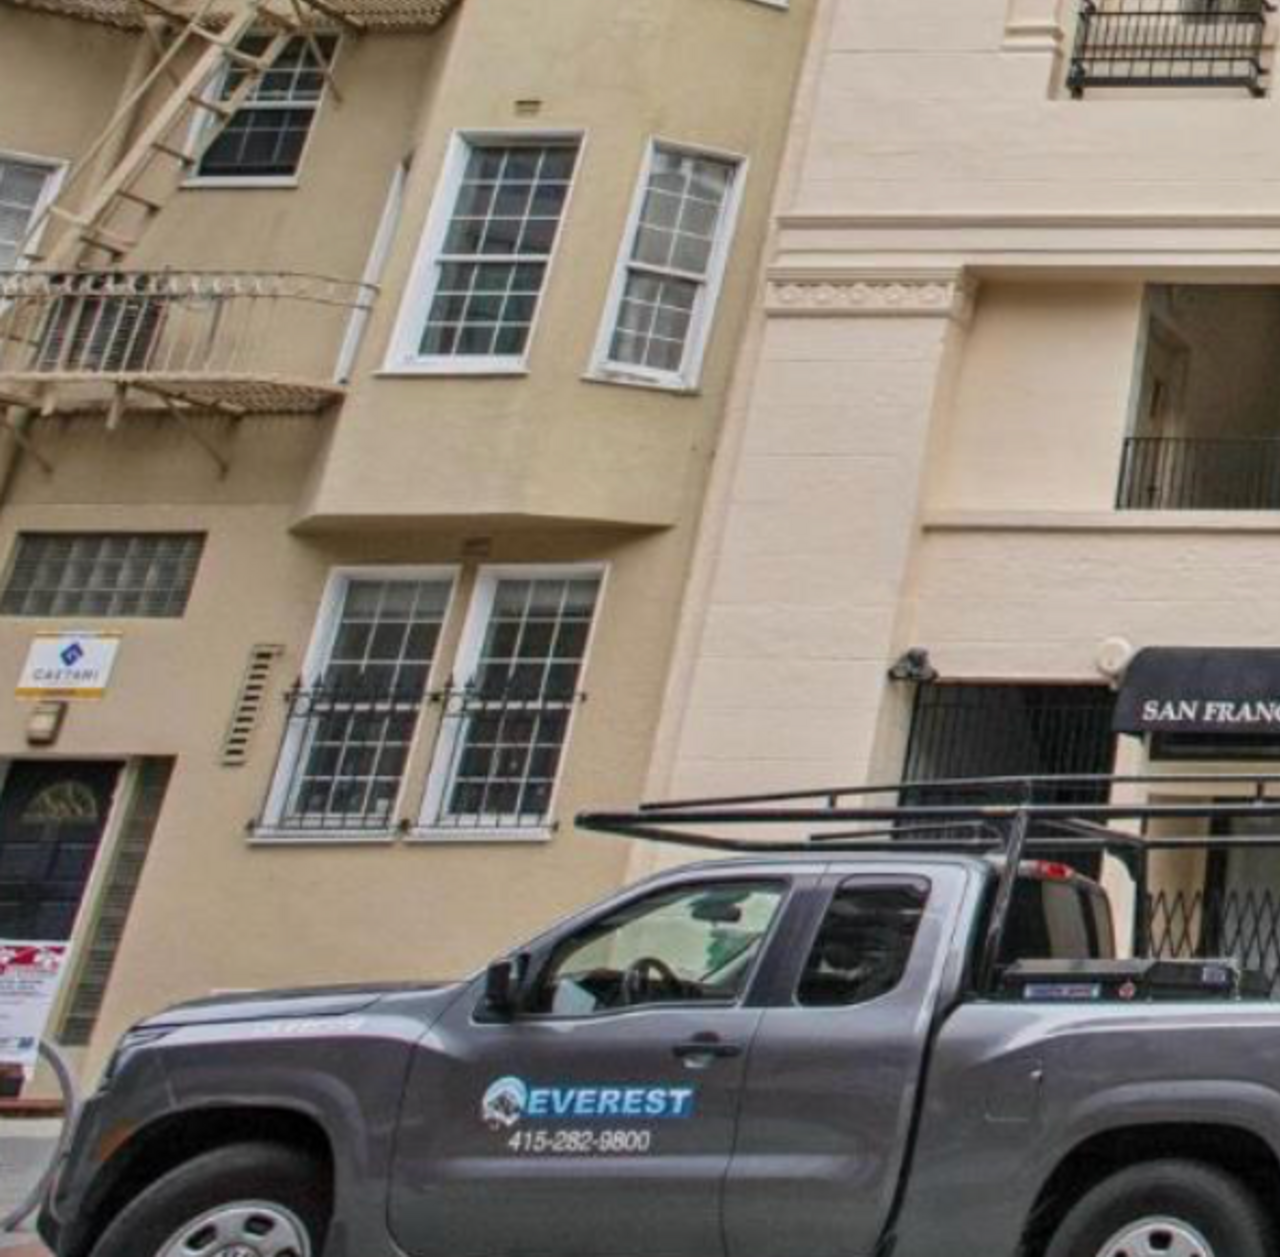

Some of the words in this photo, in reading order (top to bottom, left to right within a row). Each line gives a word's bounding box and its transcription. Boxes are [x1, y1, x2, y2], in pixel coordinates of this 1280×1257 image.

[1143, 700, 1199, 722] SAN
[528, 1089, 693, 1114] EVEREST
[508, 1130, 651, 1152] 415-282-9800
